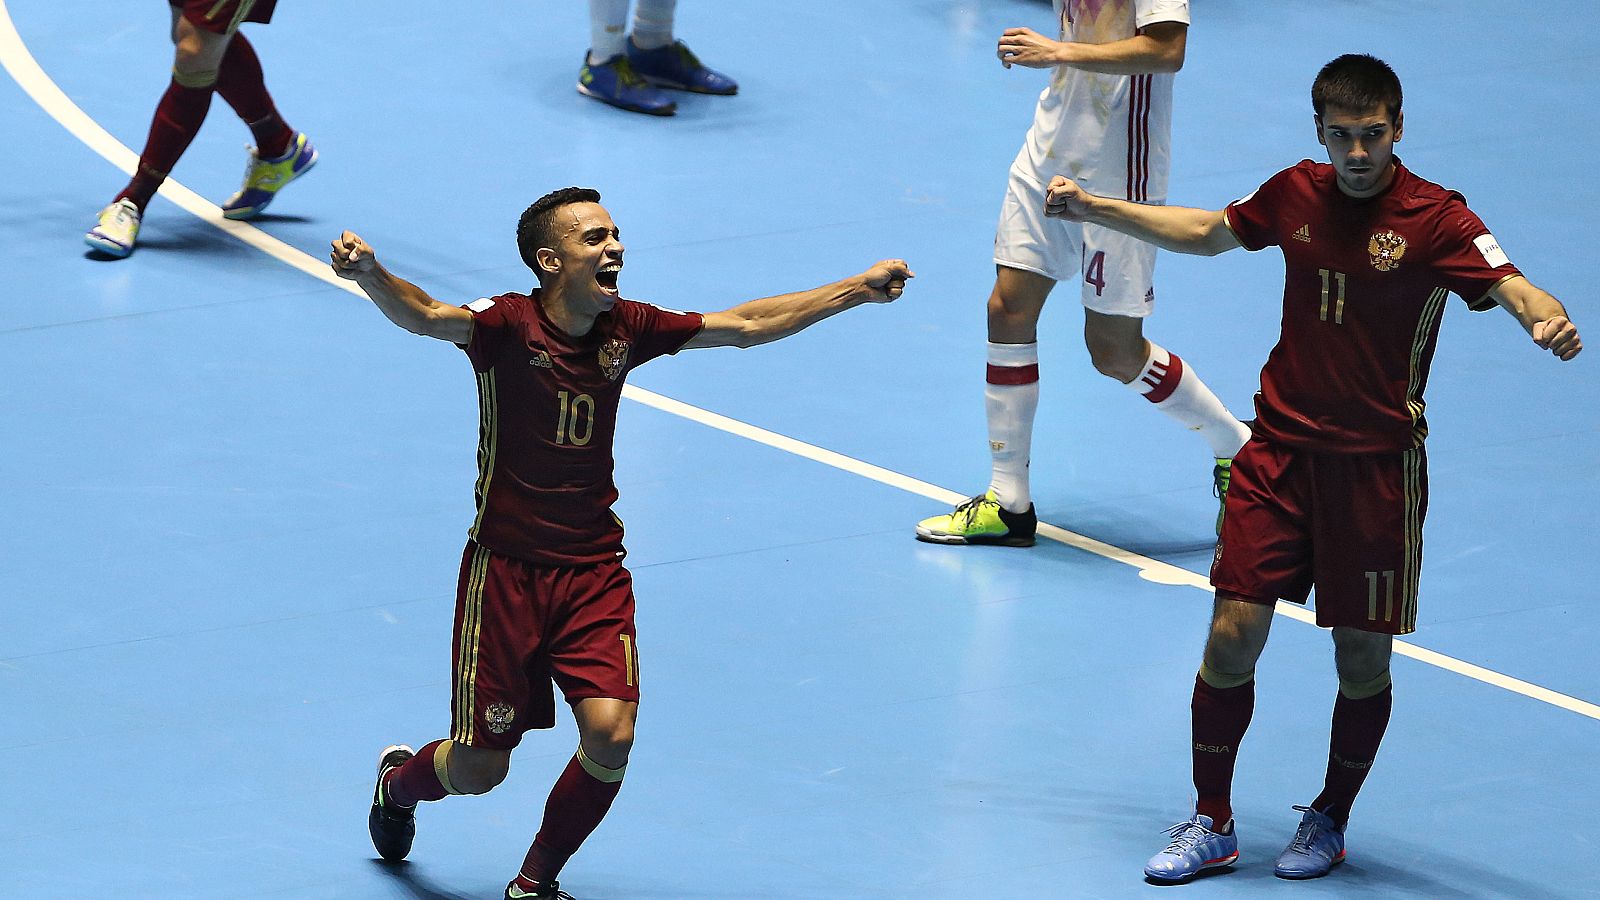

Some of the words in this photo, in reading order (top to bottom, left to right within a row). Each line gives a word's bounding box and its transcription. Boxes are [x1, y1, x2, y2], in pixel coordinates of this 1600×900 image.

[1082, 241, 1105, 297] 4
[1318, 268, 1346, 325] 11
[555, 390, 595, 446] 10
[1364, 570, 1395, 622] 11
[619, 633, 639, 687] 1
